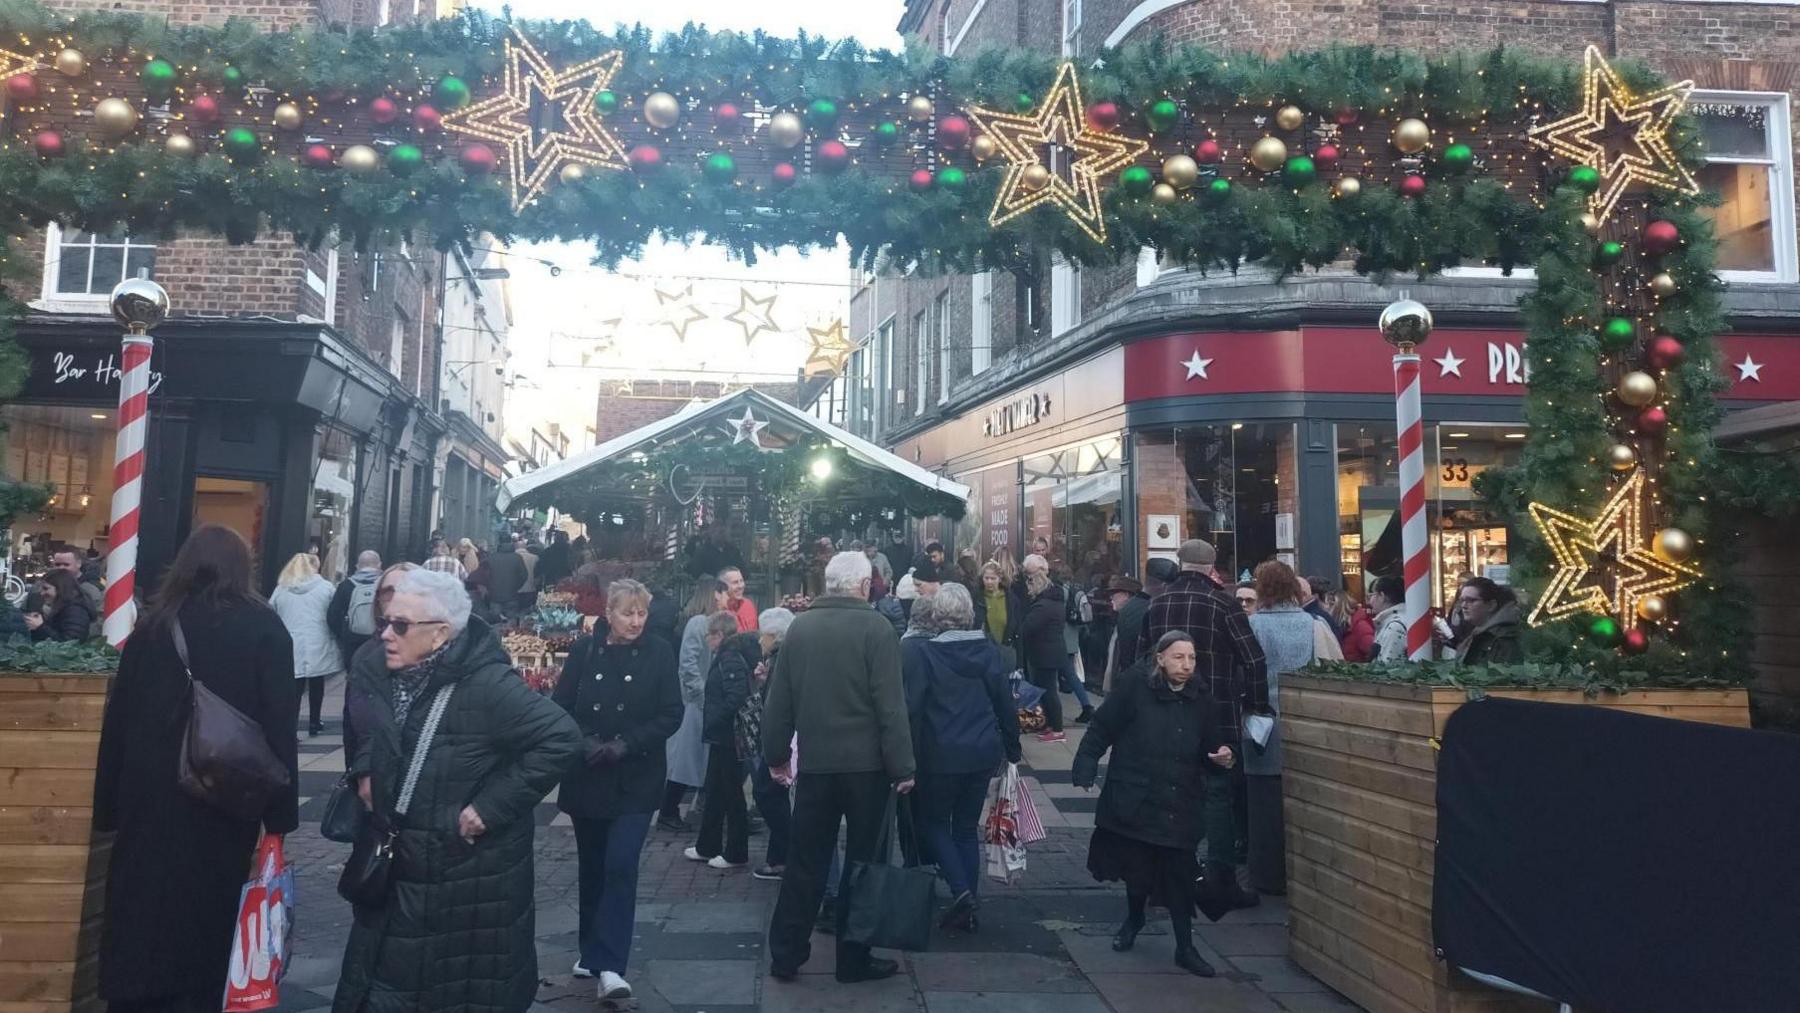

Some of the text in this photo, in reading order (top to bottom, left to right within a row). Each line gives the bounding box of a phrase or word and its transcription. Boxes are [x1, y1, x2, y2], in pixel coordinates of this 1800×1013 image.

[53, 352, 88, 384] Bar
[1442, 458, 1469, 482] 33
[991, 508, 1009, 526] MADE
[991, 529, 1009, 546] FOOD
